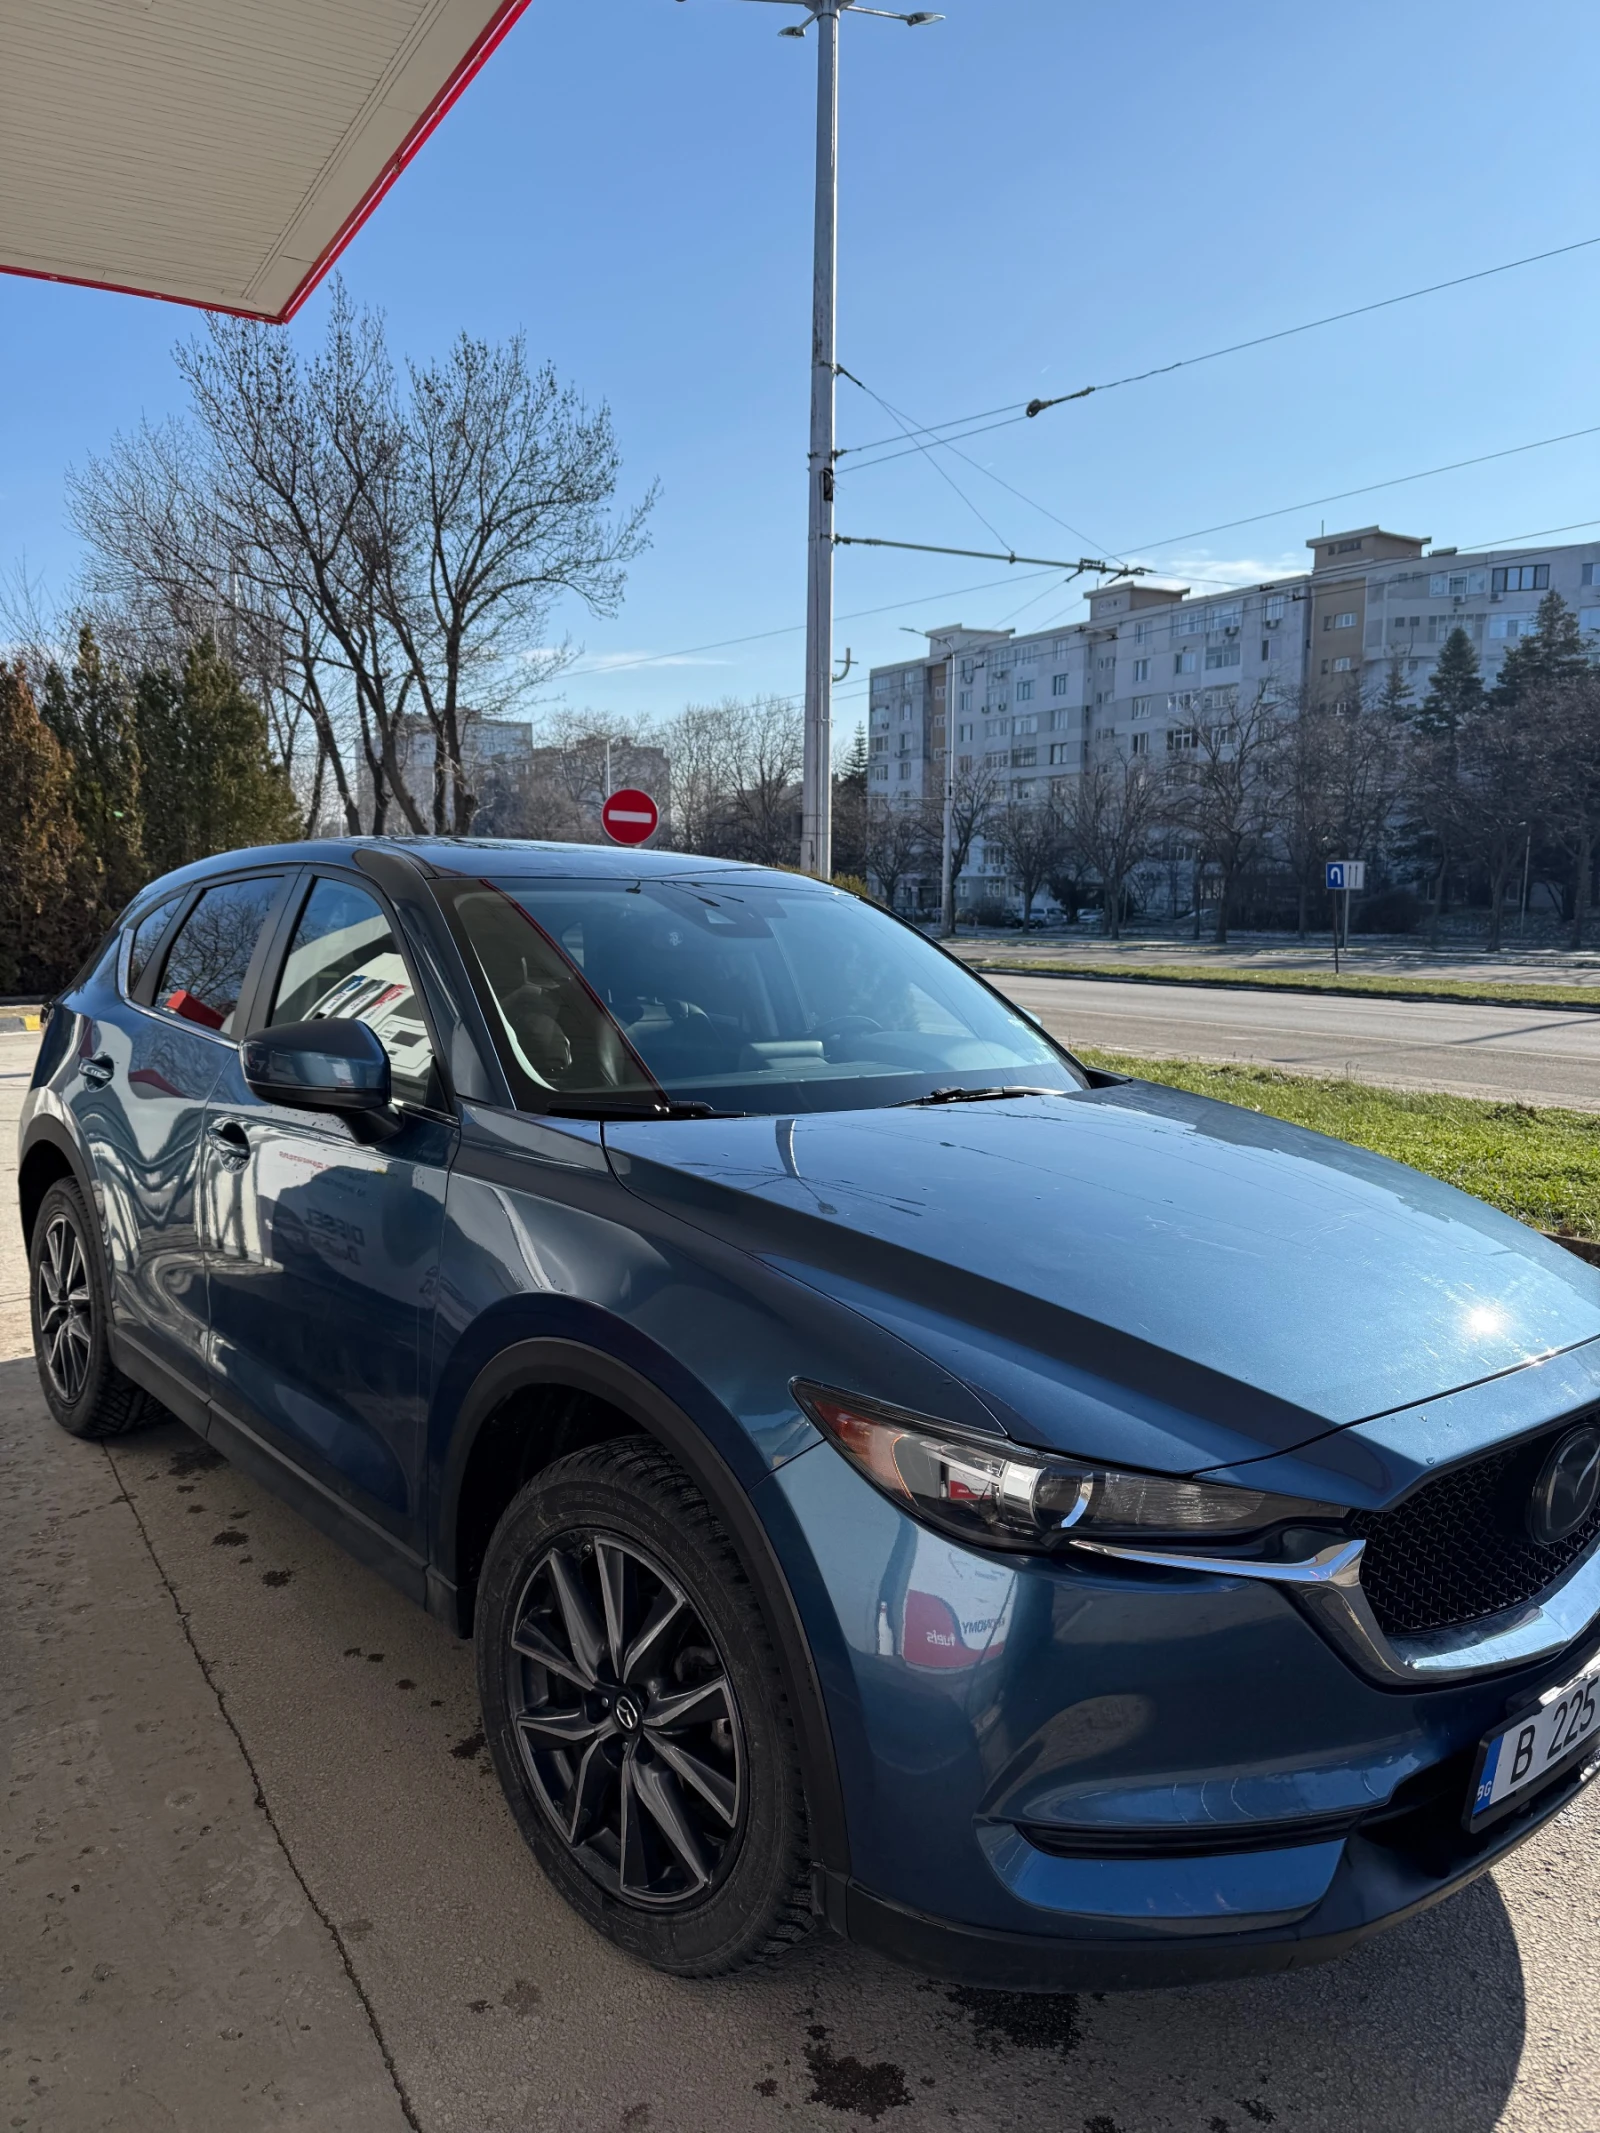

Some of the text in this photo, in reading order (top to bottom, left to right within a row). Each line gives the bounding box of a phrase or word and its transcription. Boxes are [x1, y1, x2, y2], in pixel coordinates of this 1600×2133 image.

[1510, 1676, 1600, 1785] B 225
[1477, 1780, 1492, 1802] BG
